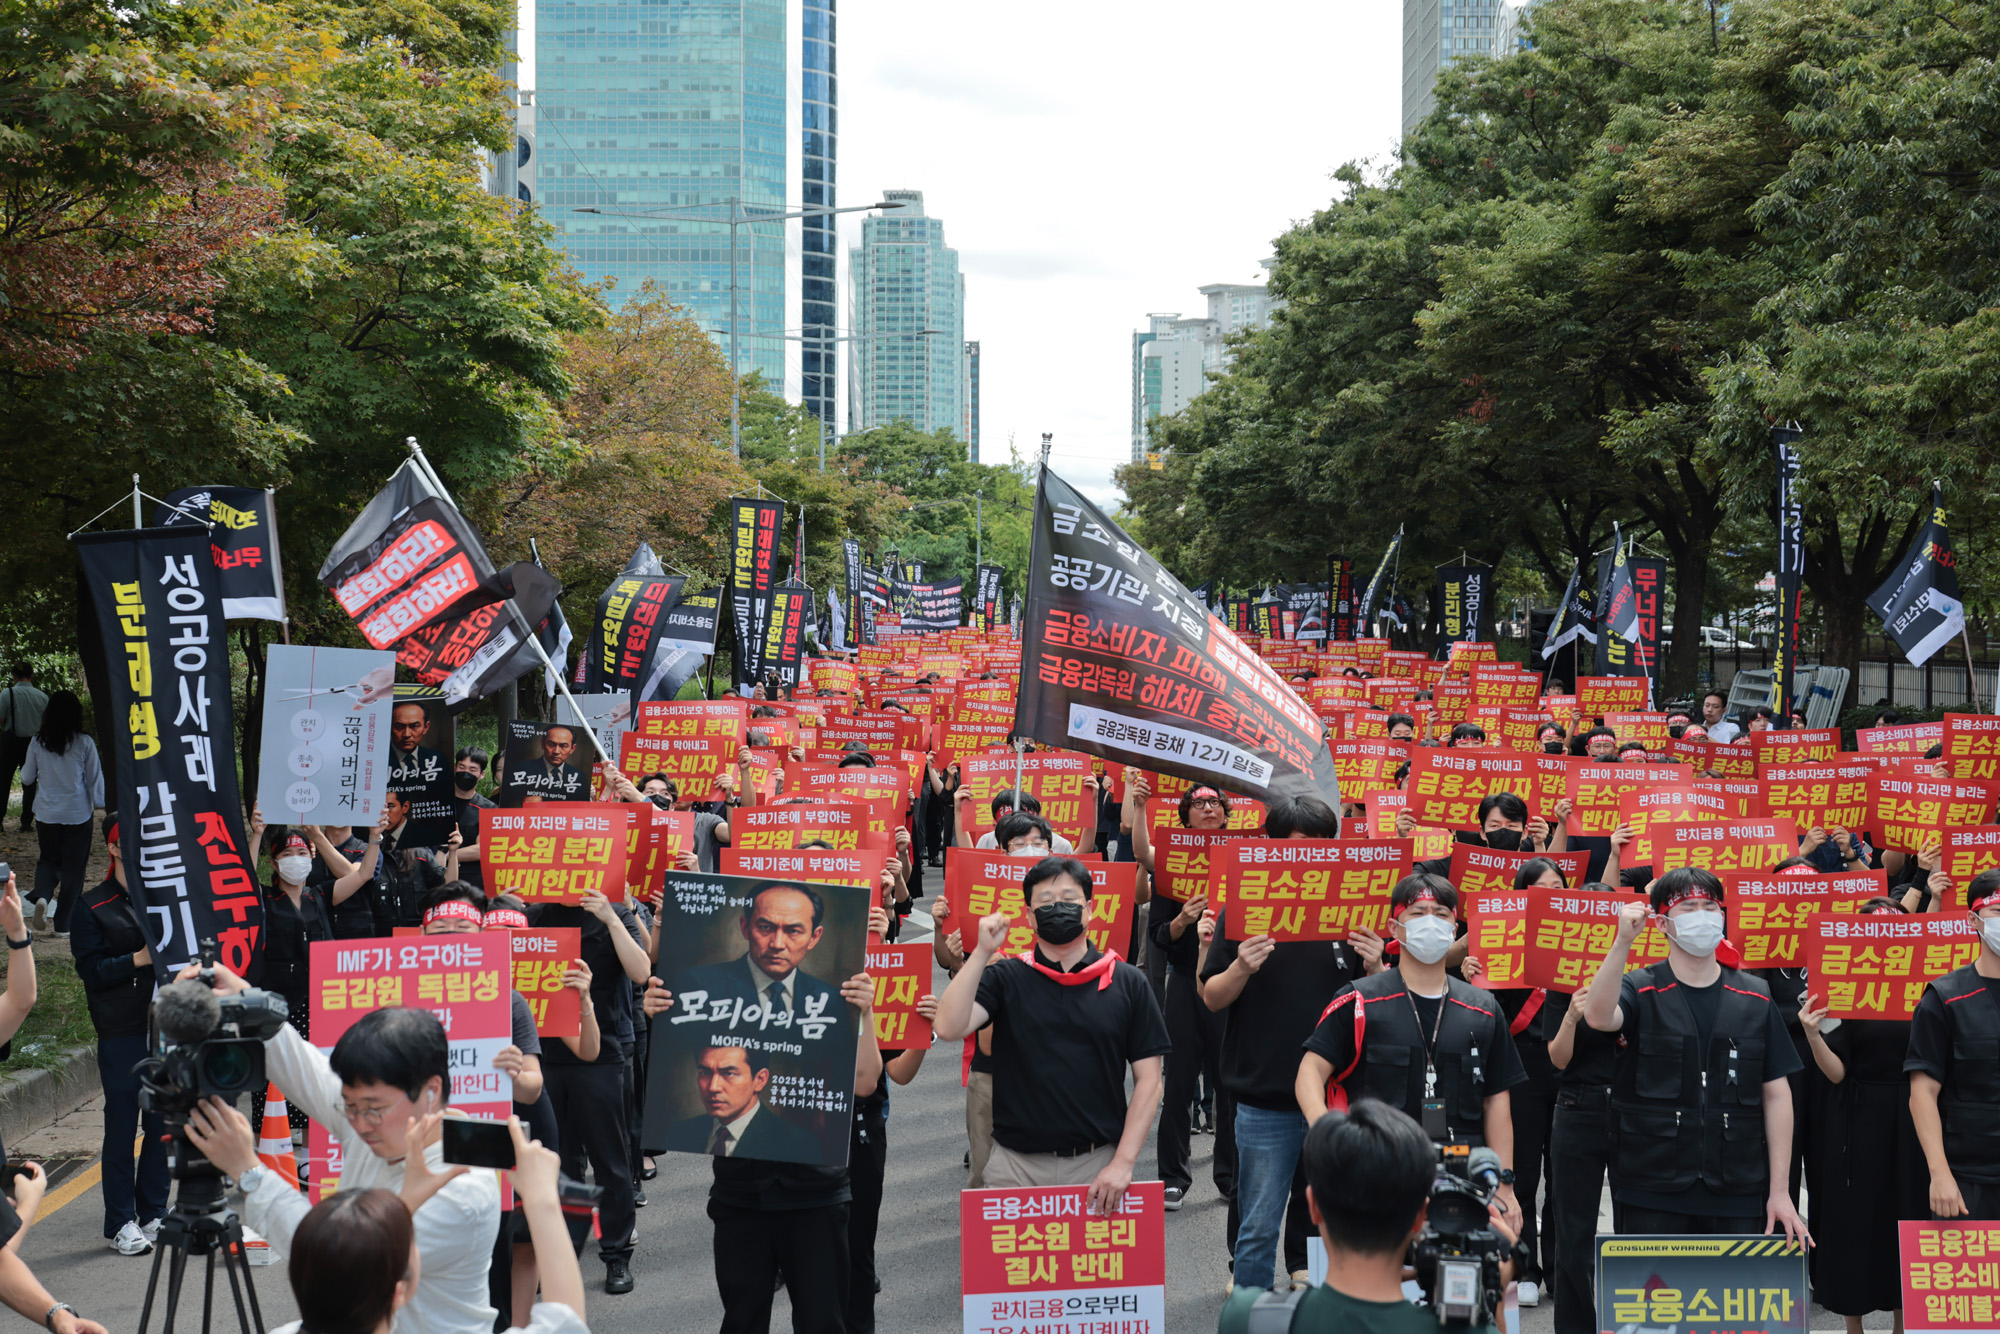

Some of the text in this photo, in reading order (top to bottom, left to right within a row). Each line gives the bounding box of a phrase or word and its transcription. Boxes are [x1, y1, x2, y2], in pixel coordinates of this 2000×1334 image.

[1053, 502, 1142, 566] 금소원
[734, 506, 755, 589] 독립없는
[756, 509, 776, 590] 미래없는
[335, 524, 444, 618] 철회하라!
[988, 574, 999, 598] 금소원
[364, 562, 469, 644] 철회하라!
[1445, 582, 1461, 636] 분리형
[603, 580, 643, 674] 독립없는
[620, 583, 671, 679] 미래없는
[765, 593, 788, 660] 독립없는
[781, 594, 803, 661] 미래없는
[1044, 609, 1167, 667] 금융소비자
[1169, 648, 1227, 697] 피해
[1050, 553, 1315, 736] 공공기관 지정 철회하라!
[860, 651, 879, 659] 금소원
[1453, 651, 1497, 661] 금소원 분리
[111, 580, 161, 760] 분리형
[159, 554, 216, 792] 성공사례
[922, 661, 940, 670] 금감원
[818, 680, 851, 690] 보장하라!
[1039, 652, 1137, 701] 금융감독원
[1140, 674, 1205, 718] 해체
[1476, 673, 1516, 682] 금융소비자보호
[992, 691, 1011, 701] 분리
[1475, 682, 1538, 697] 금소원 분리
[1581, 689, 1644, 702] 금융소비자
[645, 706, 739, 716] 금융소비자보호 역행하는
[912, 704, 932, 715] 분리
[966, 701, 1014, 713] 관치금융 막아내고
[1509, 713, 1539, 721] 국제기준에
[300, 719, 316, 727] 관치
[834, 717, 895, 728] 모피아 자리만 늘리는
[950, 724, 981, 732] 국제기준에
[822, 730, 895, 740] 금융소비자보호 역행하는
[945, 735, 978, 748] 금감원
[1766, 733, 1830, 744] 관치금융 막아내고
[1866, 726, 1943, 742] 금융소비자 울리는
[674, 740, 709, 750] 막아내고
[1096, 717, 1266, 779] 금융감독원 공채 12기 일동
[1336, 745, 1408, 757] 모피아 자리만 늘리는
[338, 716, 362, 811] 끊어버리자
[421, 755, 443, 781] 봄
[624, 752, 718, 775] 금융소비자
[1043, 759, 1083, 769] 역행하는
[1432, 755, 1522, 771] 관치금융 막아내고
[1767, 766, 1873, 780] 금융소비자보호 역행하는
[1953, 759, 1997, 779] 결사
[510, 771, 581, 793] 모피아의 봄
[810, 775, 897, 784] 모피아 자리만 늘리는
[1580, 769, 1679, 781] 모피아 자리만 늘리는
[295, 788, 311, 796] 자리
[406, 784, 426, 792] spring
[1417, 771, 1532, 801] 금융소비자
[1725, 784, 1759, 794] 막아내고
[1768, 782, 1830, 805] 금소원
[1880, 780, 1952, 797] 모피아 자리만
[363, 798, 370, 813] 위해
[1639, 793, 1725, 809] 관치금융 막아내고
[747, 812, 801, 826] 국제기준에
[1823, 807, 1867, 829] 반대!
[1877, 797, 1987, 826] 금소원 분리
[492, 816, 610, 831] 모피아 자리만 늘리는
[1676, 826, 1775, 841] 관치금융 막아내고
[489, 836, 614, 864] 금소원 분리
[1170, 834, 1206, 847] 모피아
[739, 857, 861, 871] 국제기준에 부합하는
[1238, 846, 1402, 863] 금융소비자보호 역행하는
[494, 869, 605, 897] 반대한다!
[1239, 868, 1400, 900] 금소원 분리
[1738, 878, 1879, 896] 금융소비자보호 역행하는
[1244, 904, 1392, 935] 결사 반대!
[1820, 922, 1922, 938] 금융소비자보호
[1744, 934, 1800, 961] 결사
[337, 943, 483, 973] IMF가 요구하는
[1820, 945, 1914, 976] 금소원
[322, 976, 403, 1010] 금감원
[418, 971, 499, 1004] 독립성
[1827, 982, 1890, 1012] 결사
[671, 990, 837, 1040] 모피아의 봄
[711, 1035, 802, 1056] MOFIA's spring
[982, 1194, 1081, 1220] 금융소비자
[991, 1219, 1136, 1254] 금소원 분리
[1005, 1252, 1123, 1285] 결사 반대
[991, 1294, 1138, 1320] 관치금융으로부터
[1613, 1288, 1794, 1323] 금융소비자
